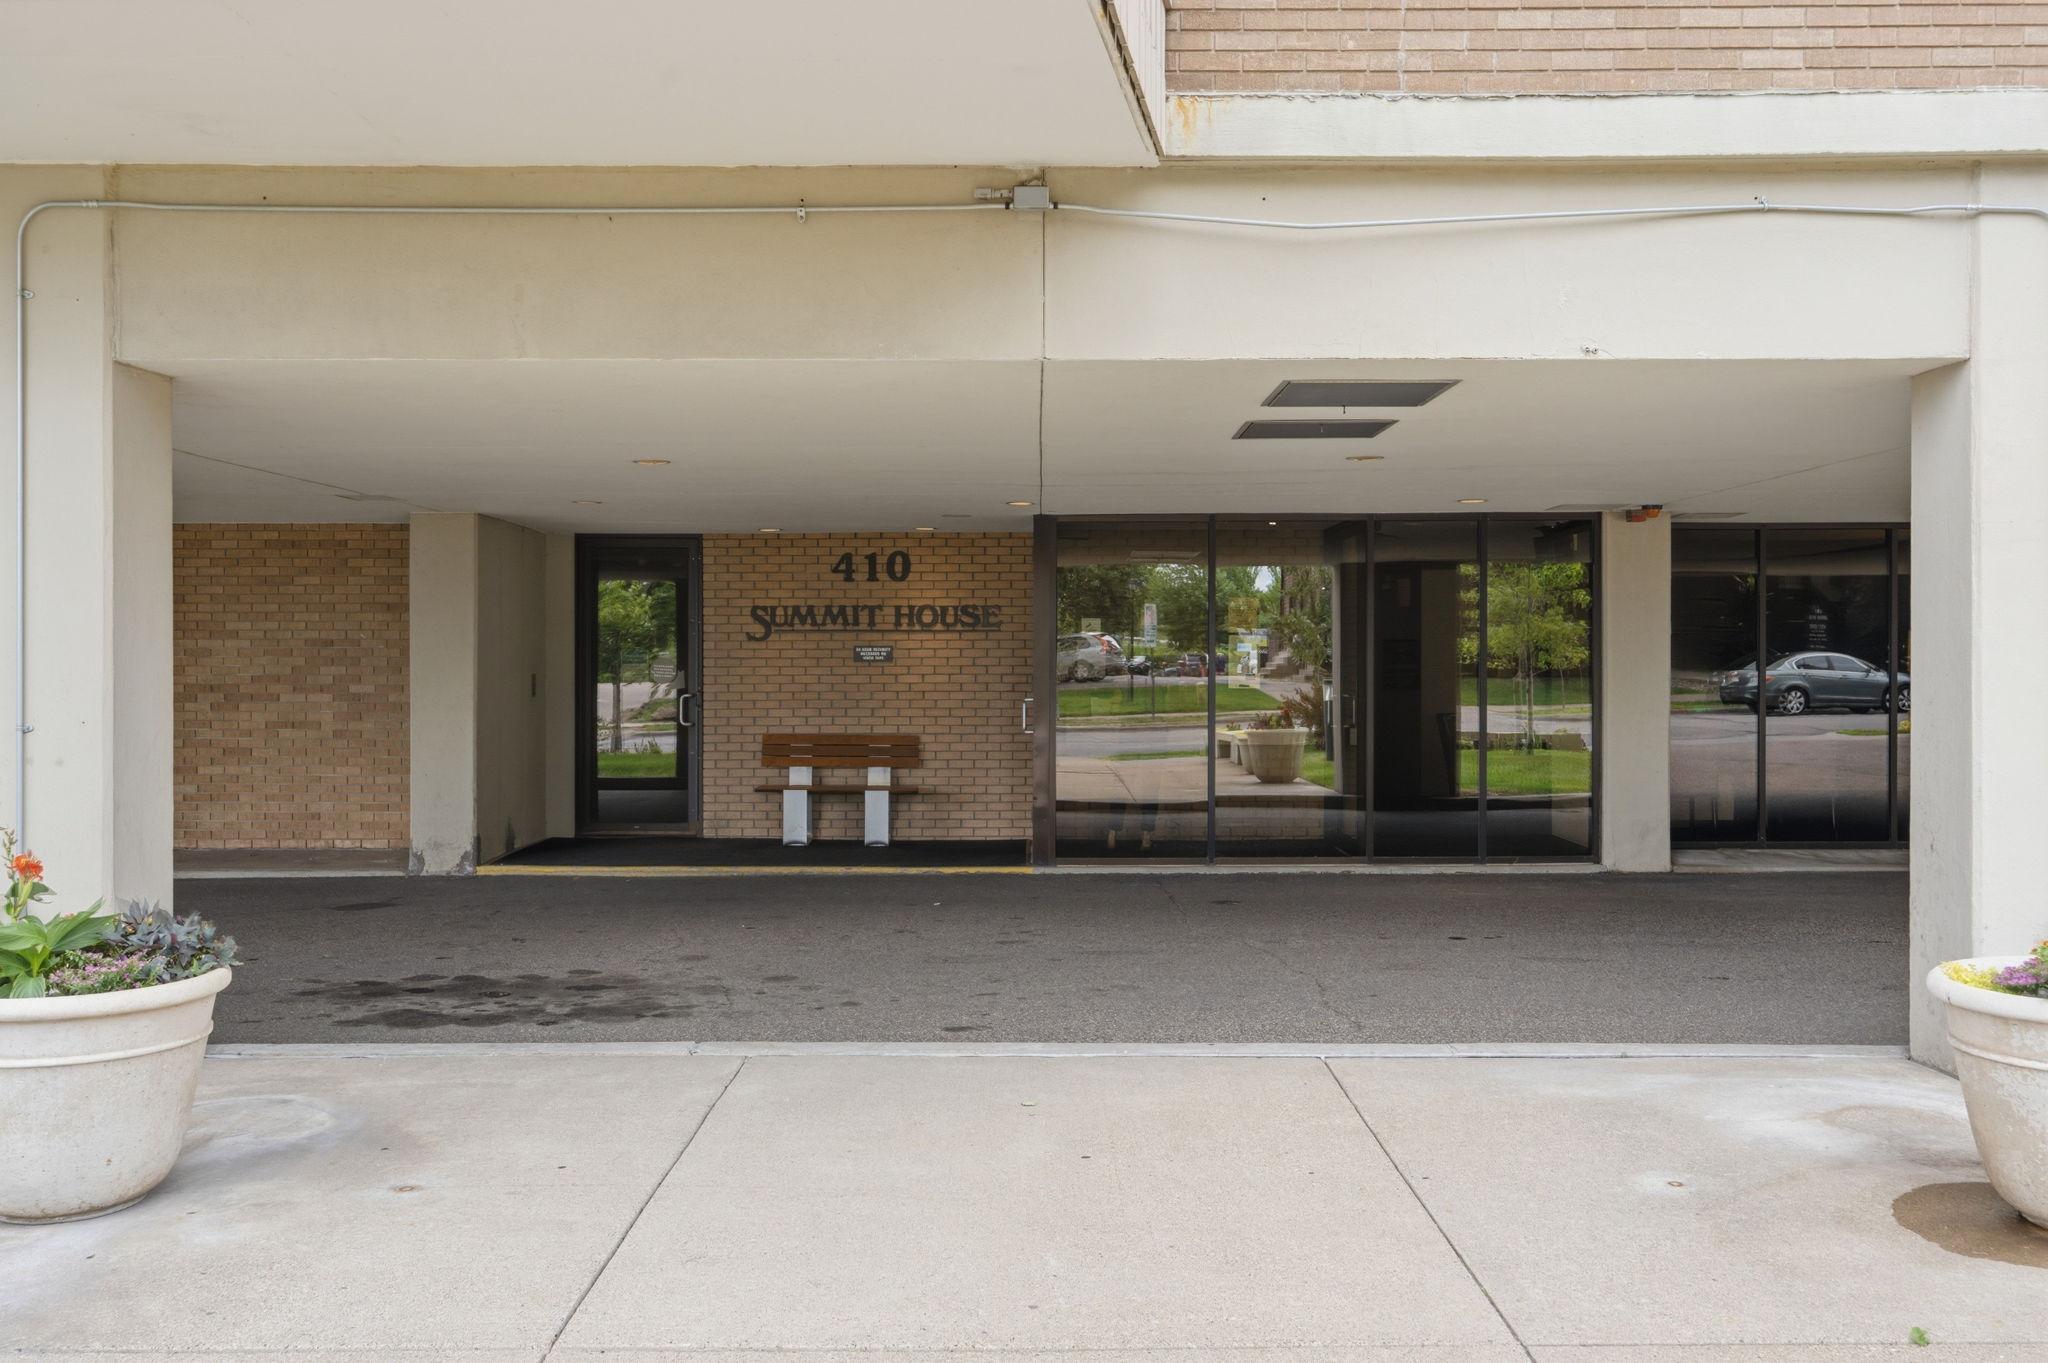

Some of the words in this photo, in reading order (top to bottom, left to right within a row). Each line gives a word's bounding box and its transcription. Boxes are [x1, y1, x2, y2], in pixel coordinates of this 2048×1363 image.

[831, 550, 911, 582] 410
[746, 604, 884, 642] SUMMIT
[894, 603, 1004, 628] HOUSE
